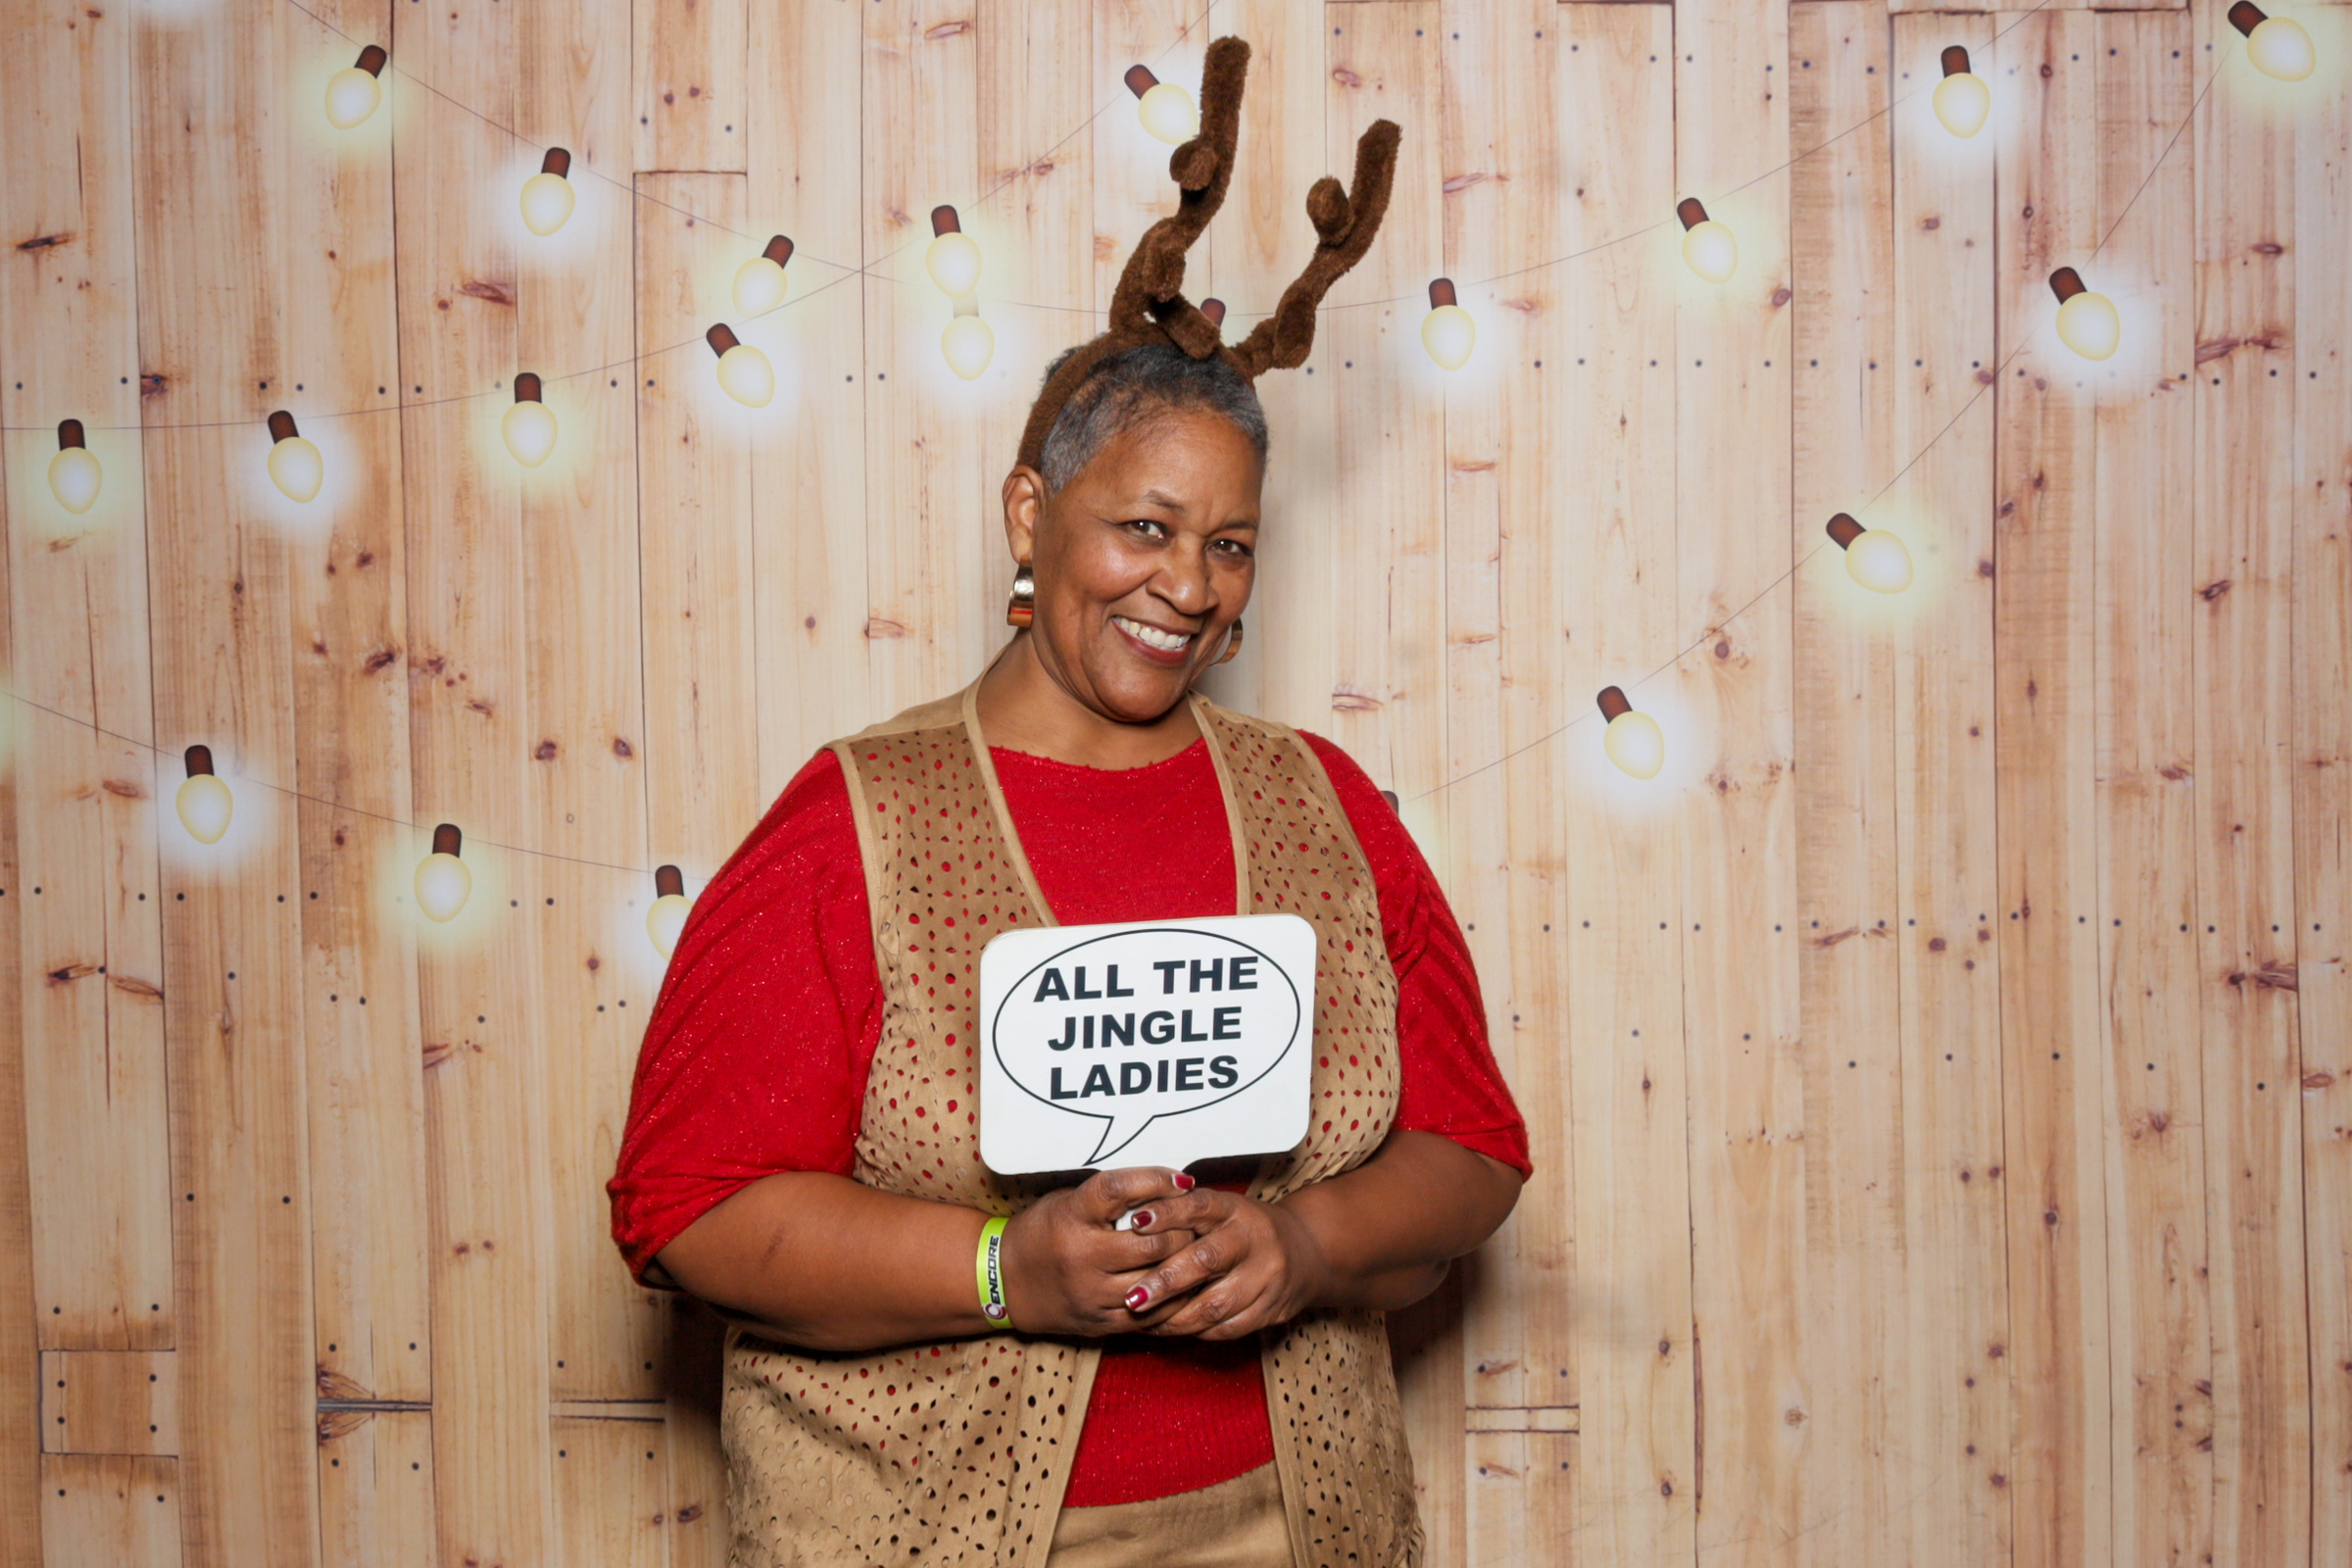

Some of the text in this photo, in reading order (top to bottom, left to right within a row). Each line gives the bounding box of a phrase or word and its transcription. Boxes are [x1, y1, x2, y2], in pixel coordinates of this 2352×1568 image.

[1033, 956, 1259, 1003] ALL THE
[1048, 1006, 1243, 1052] JINGLE
[1050, 1055, 1240, 1101] LADIES
[988, 1235, 1002, 1305] ENCORE
